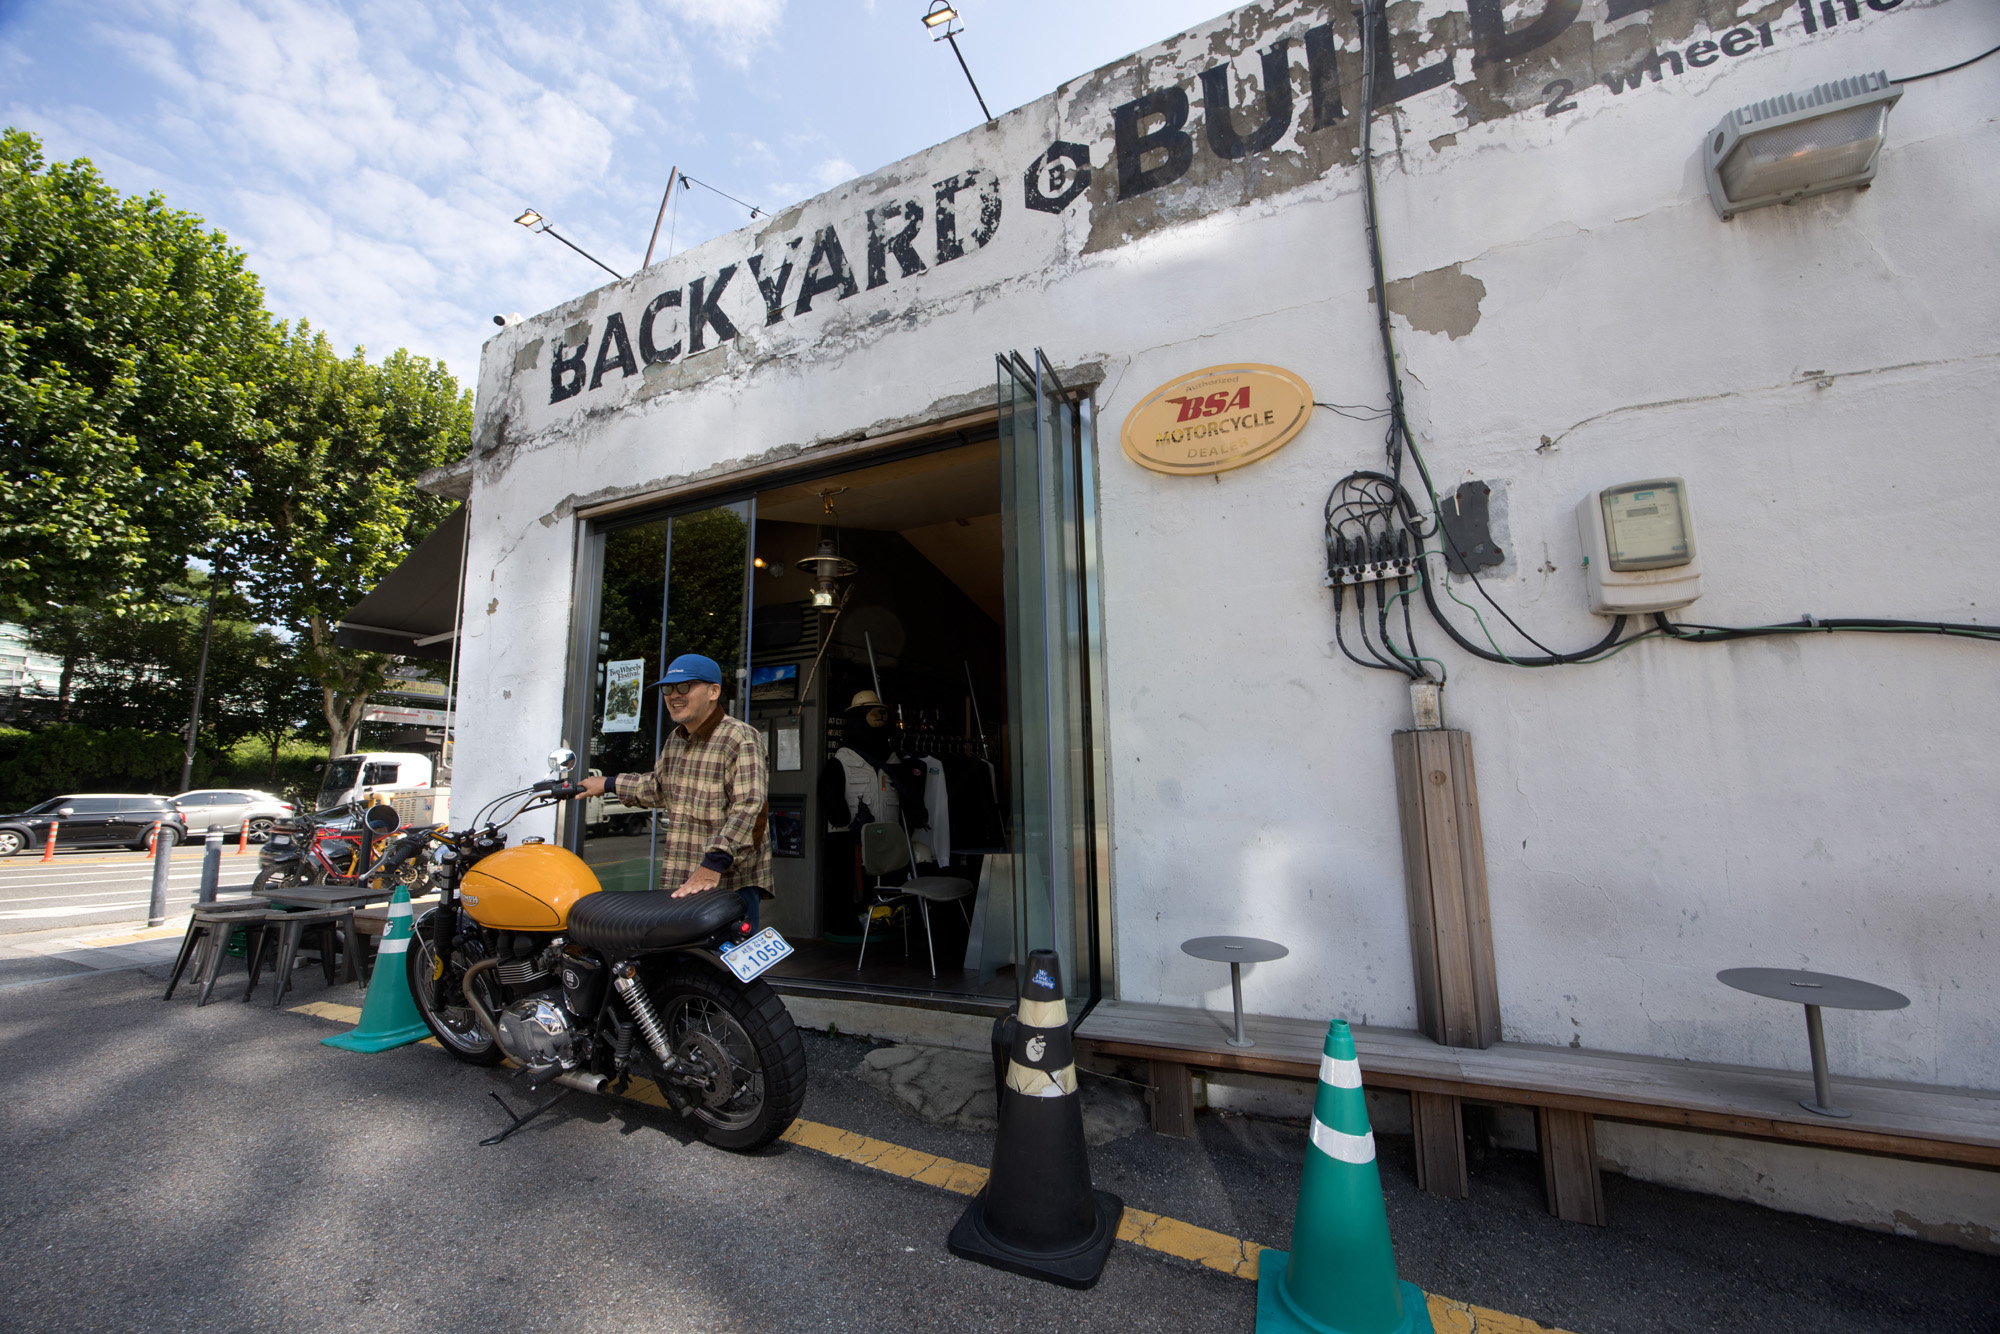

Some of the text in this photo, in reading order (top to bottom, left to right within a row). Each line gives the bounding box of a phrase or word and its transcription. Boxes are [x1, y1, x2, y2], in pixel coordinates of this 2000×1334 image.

[1541, 78, 1578, 117] 2
[548, 168, 1001, 405] BACKYARD
[1185, 376, 1240, 393] Authorized
[1174, 386, 1251, 423] BSA
[1155, 410, 1275, 448] MOTORCYCLE
[1187, 438, 1249, 459] DEALER
[609, 663, 642, 677] Two Wheels
[617, 672, 640, 682] Festival
[748, 939, 786, 967] 1050
